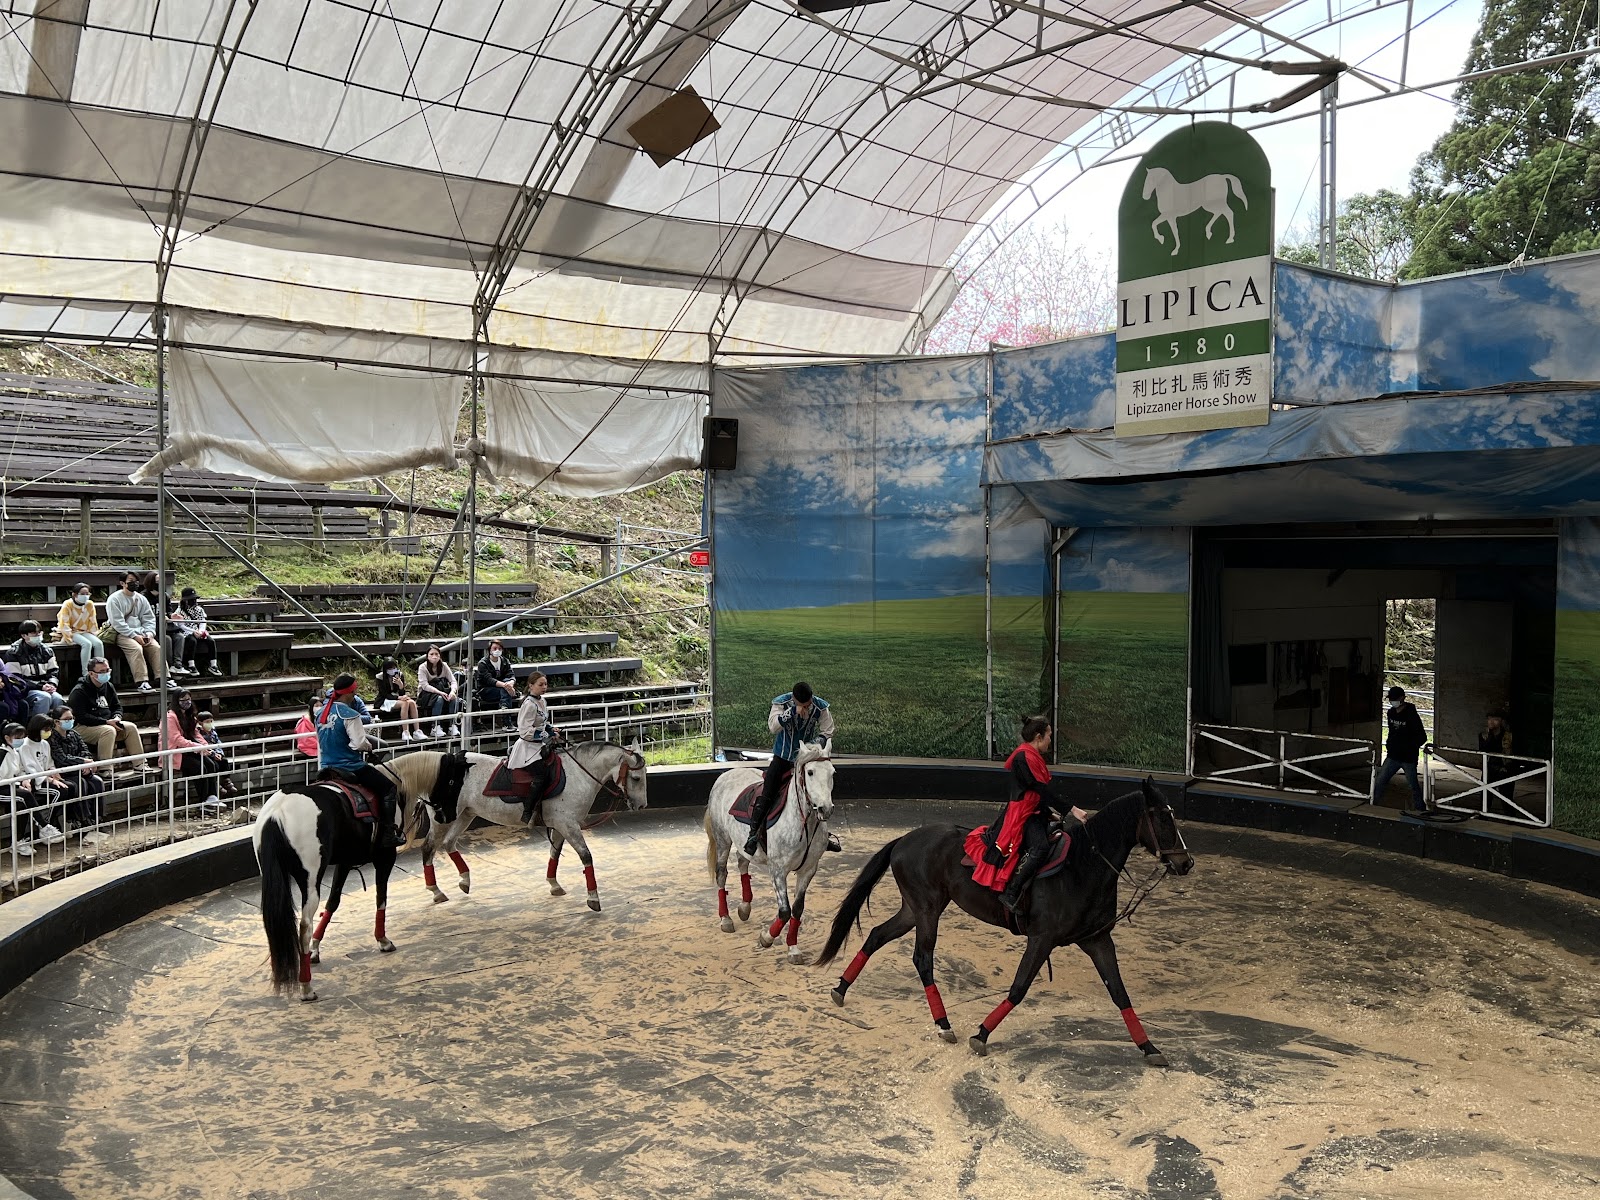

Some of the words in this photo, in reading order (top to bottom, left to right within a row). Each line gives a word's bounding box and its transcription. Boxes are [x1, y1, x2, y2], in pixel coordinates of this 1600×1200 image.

[1120, 275, 1266, 328] LIPICA
[1145, 333, 1235, 362] 1580
[1132, 366, 1253, 399] 利比扎馬術秀
[1127, 400, 1183, 418] Lipizzaner
[1185, 396, 1220, 410] Horse
[1222, 392, 1257, 406] Show
